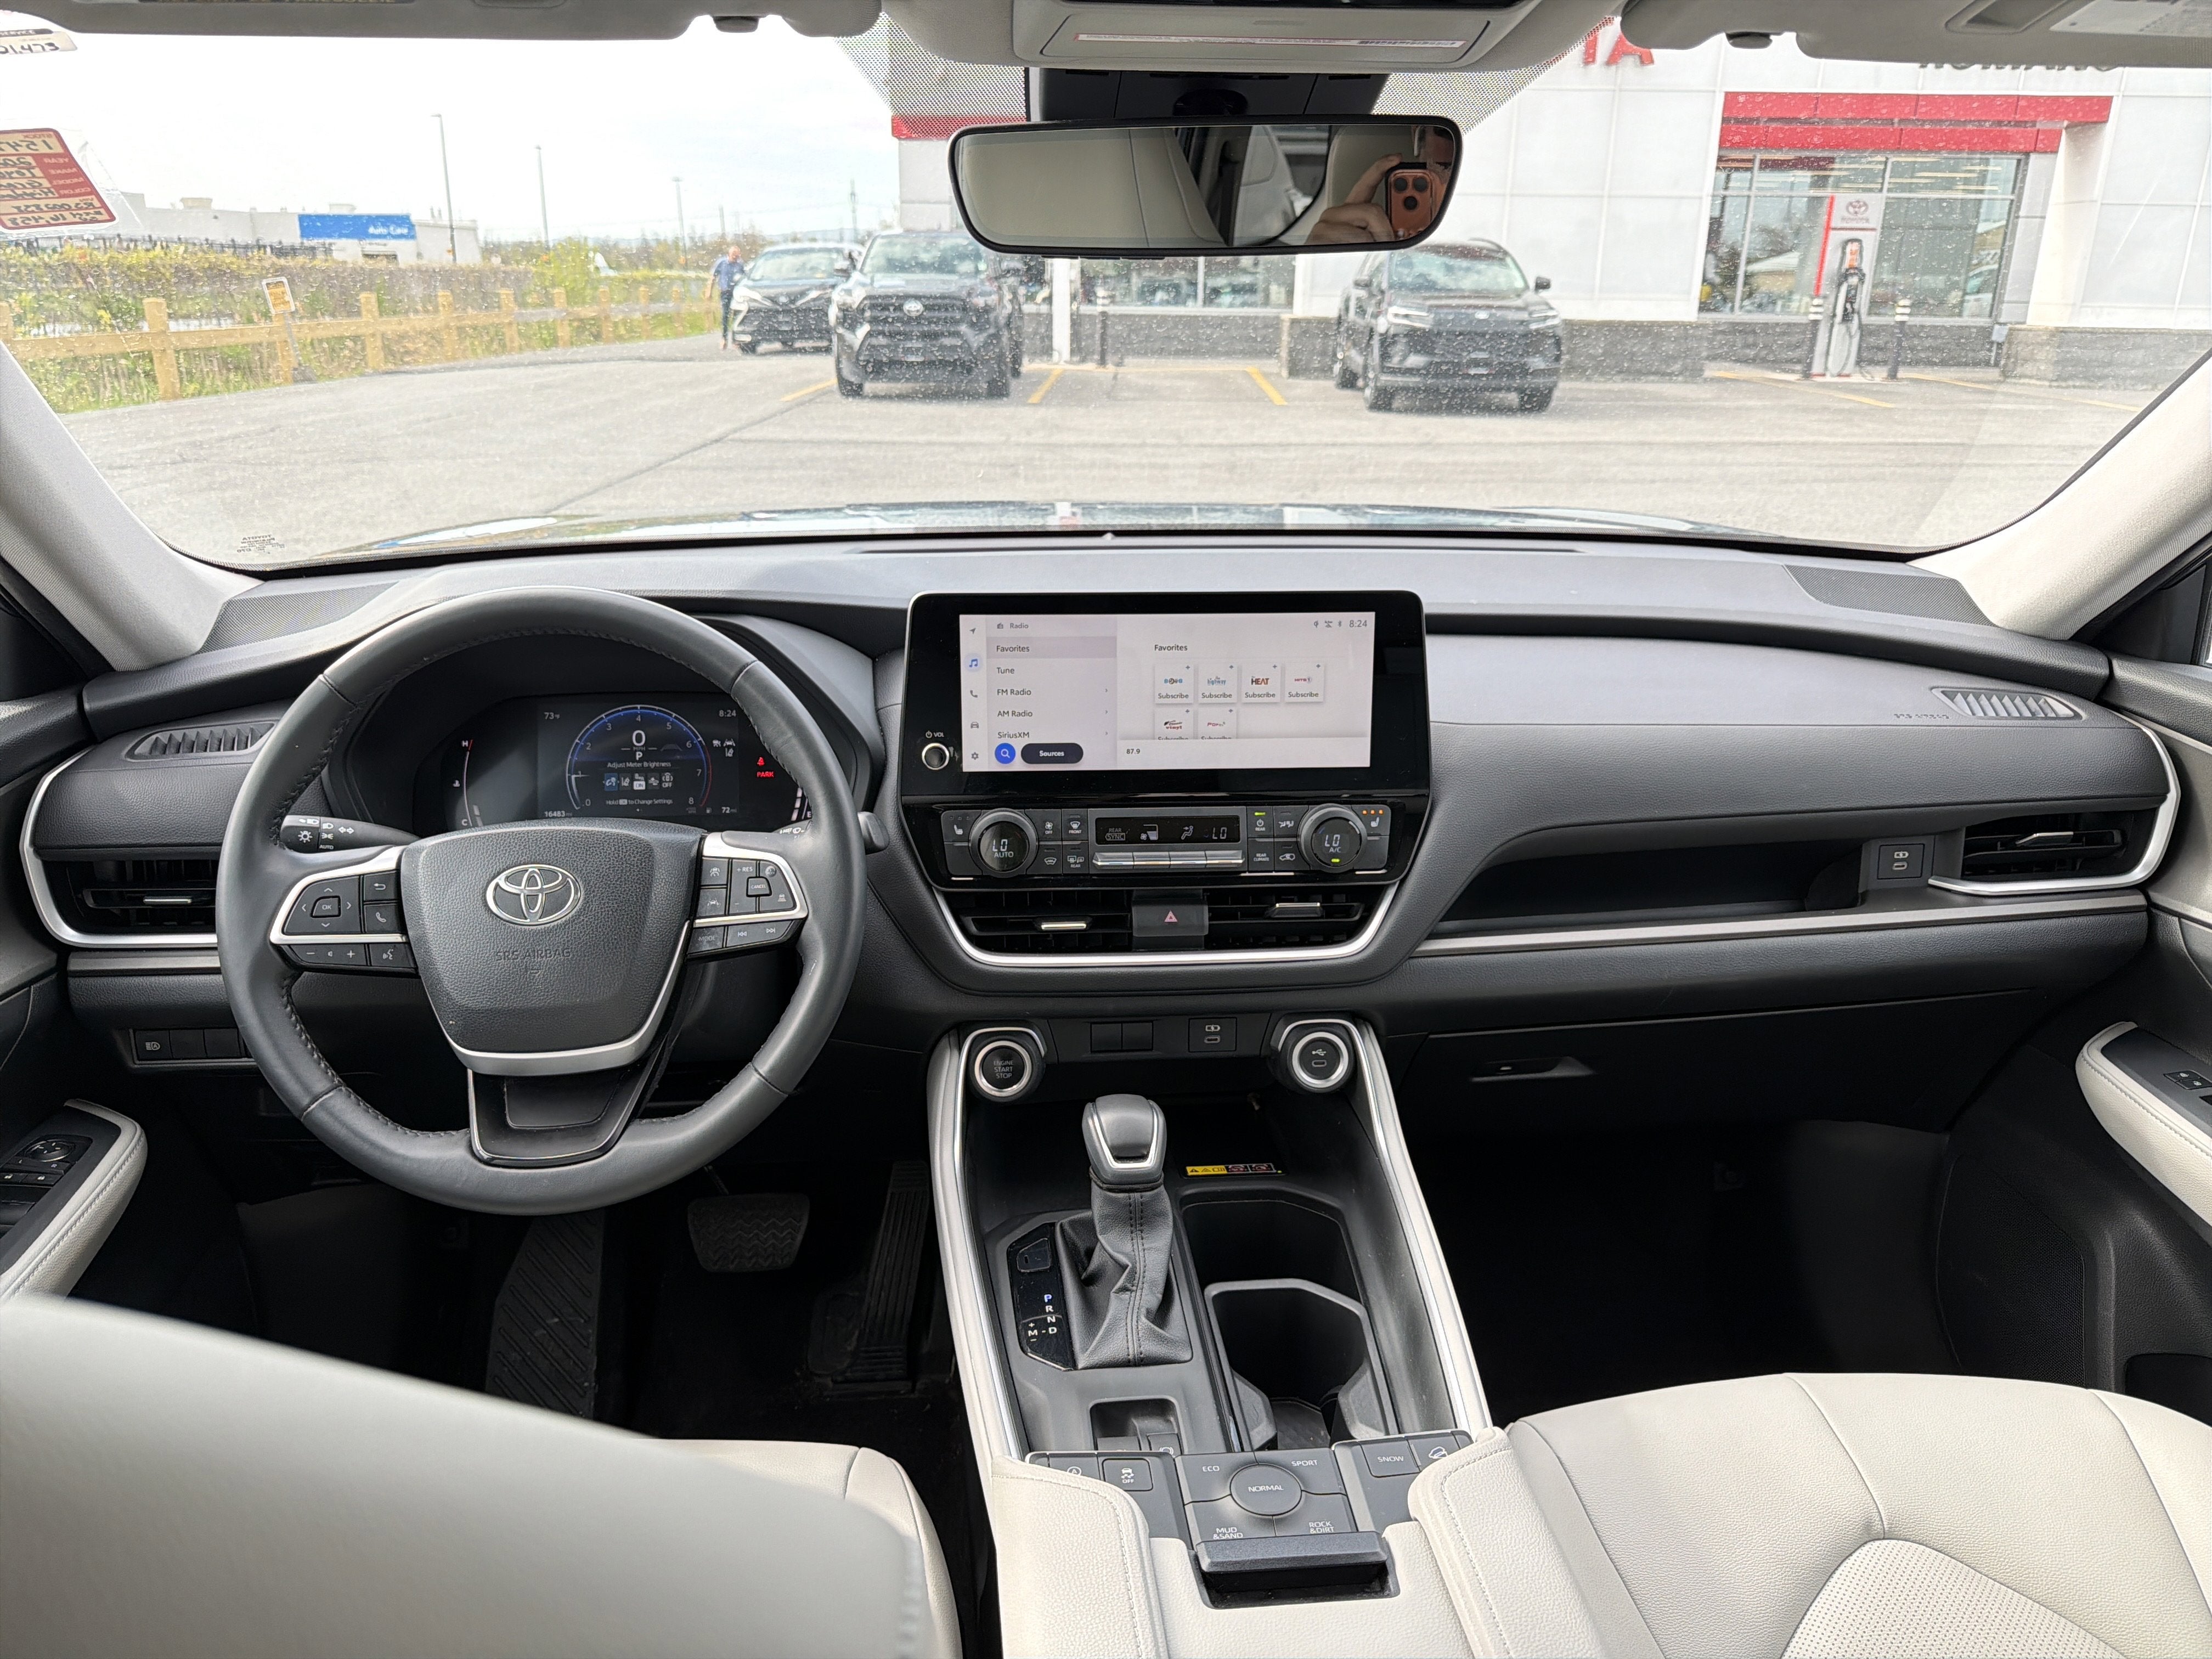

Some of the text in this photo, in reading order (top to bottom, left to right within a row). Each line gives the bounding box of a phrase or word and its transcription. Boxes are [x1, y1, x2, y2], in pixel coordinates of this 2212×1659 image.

[632, 730, 646, 746] 0
[636, 751, 643, 760] P
[496, 948, 571, 961] SRS AIRBAG
